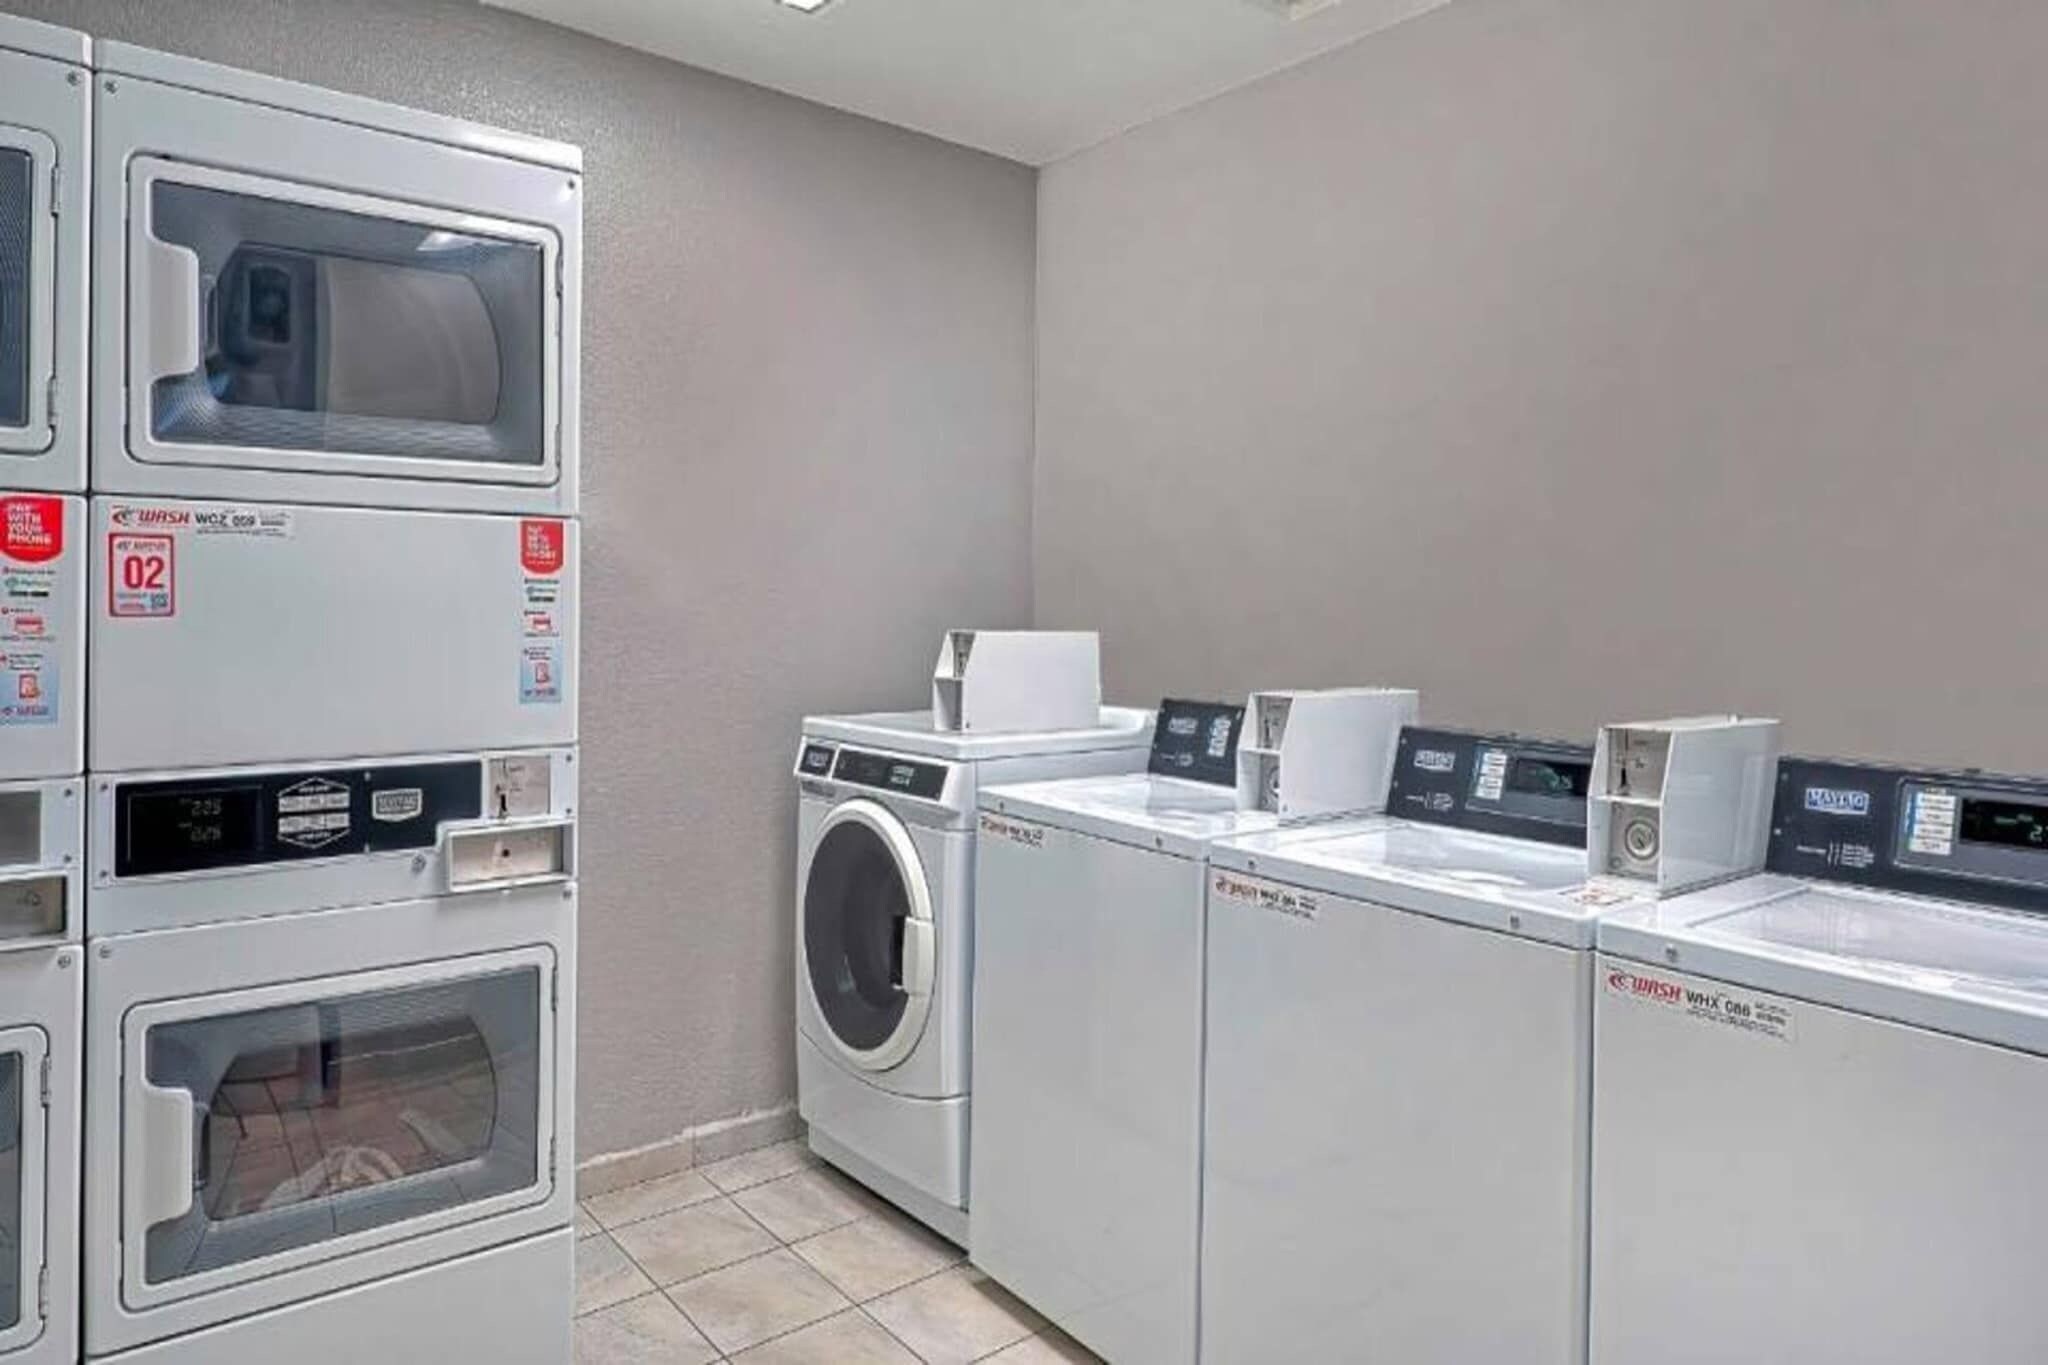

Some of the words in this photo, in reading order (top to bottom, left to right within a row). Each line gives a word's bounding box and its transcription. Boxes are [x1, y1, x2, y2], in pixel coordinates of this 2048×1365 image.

[137, 509, 191, 525] WASH
[124, 555, 165, 589] 02
[1632, 975, 1682, 1001] WASH
